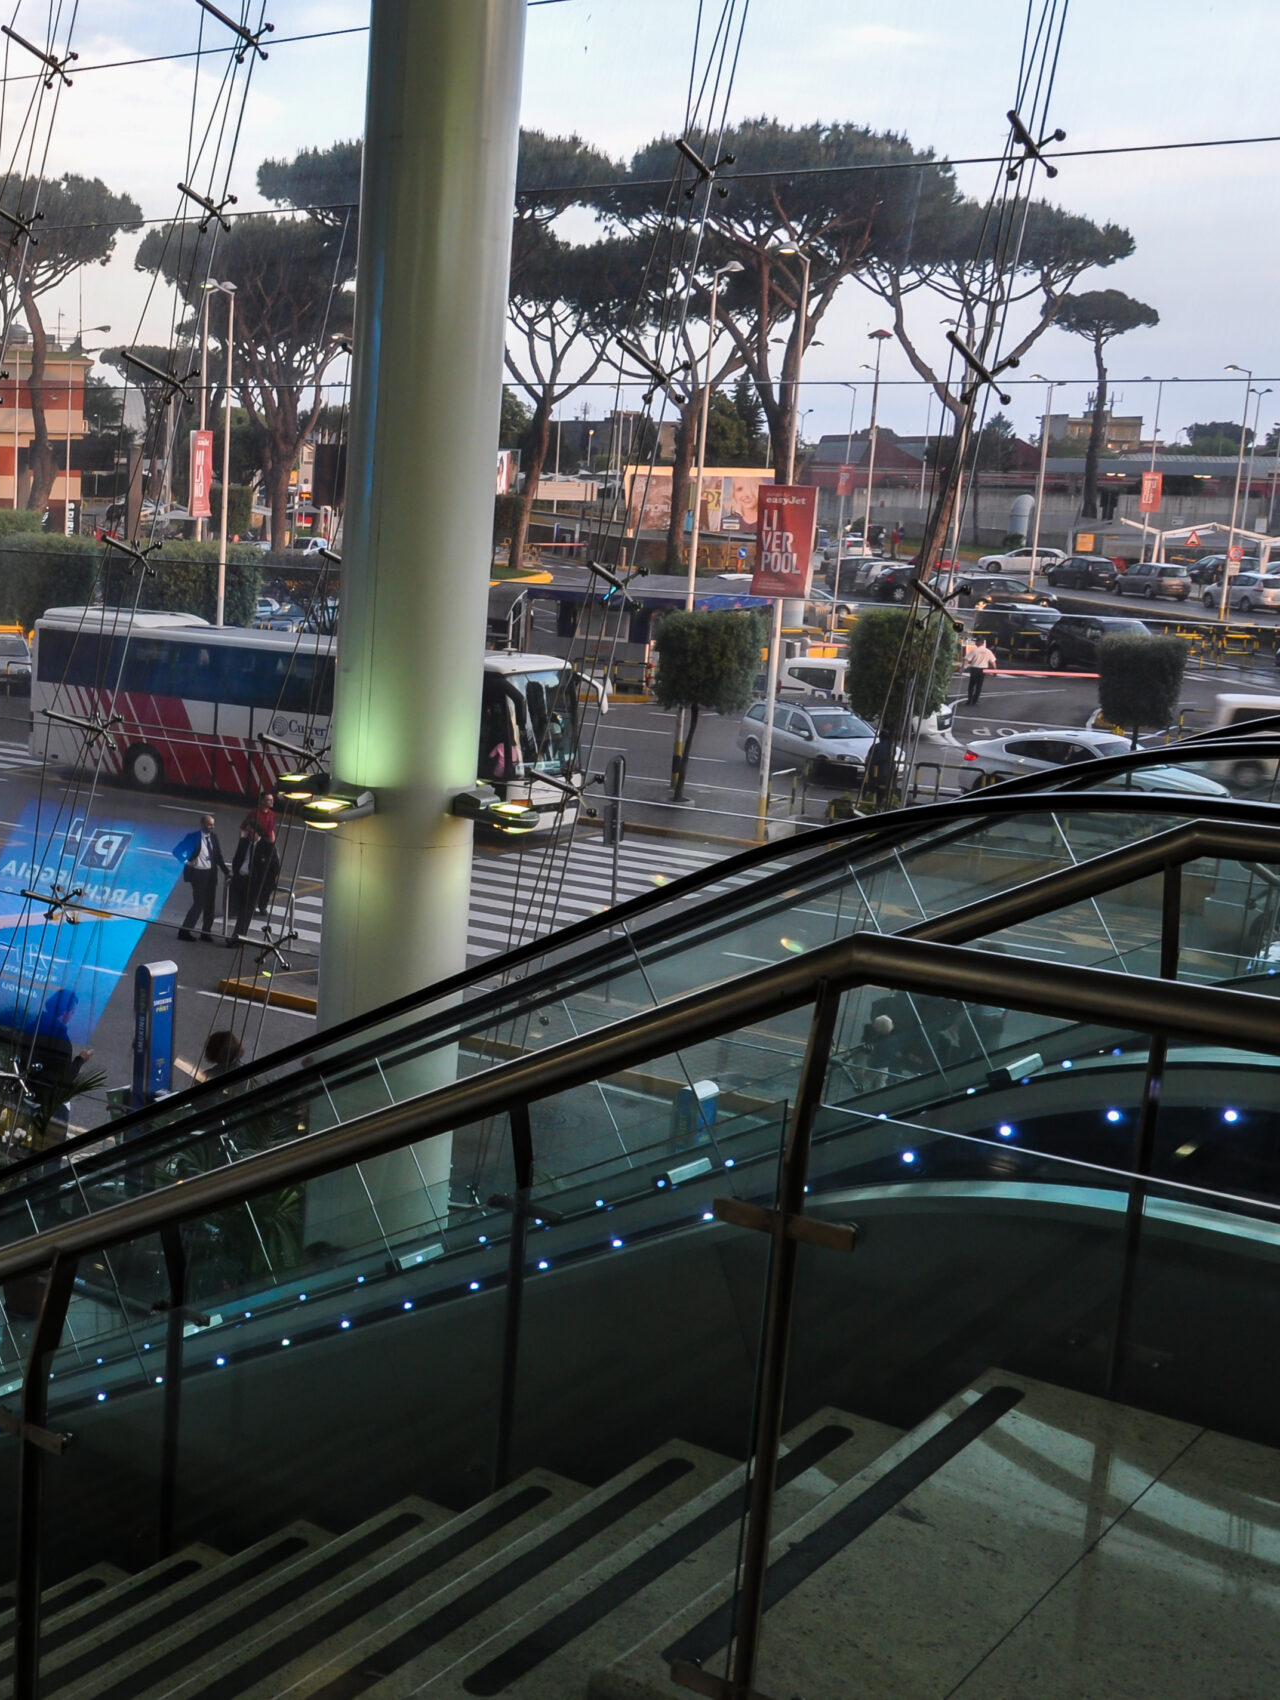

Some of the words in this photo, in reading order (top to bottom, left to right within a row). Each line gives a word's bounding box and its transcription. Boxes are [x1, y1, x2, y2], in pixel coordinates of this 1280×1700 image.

[766, 495, 807, 506] easyJet
[762, 508, 779, 531] LI
[761, 530, 794, 553] VER
[760, 551, 801, 575] POOL
